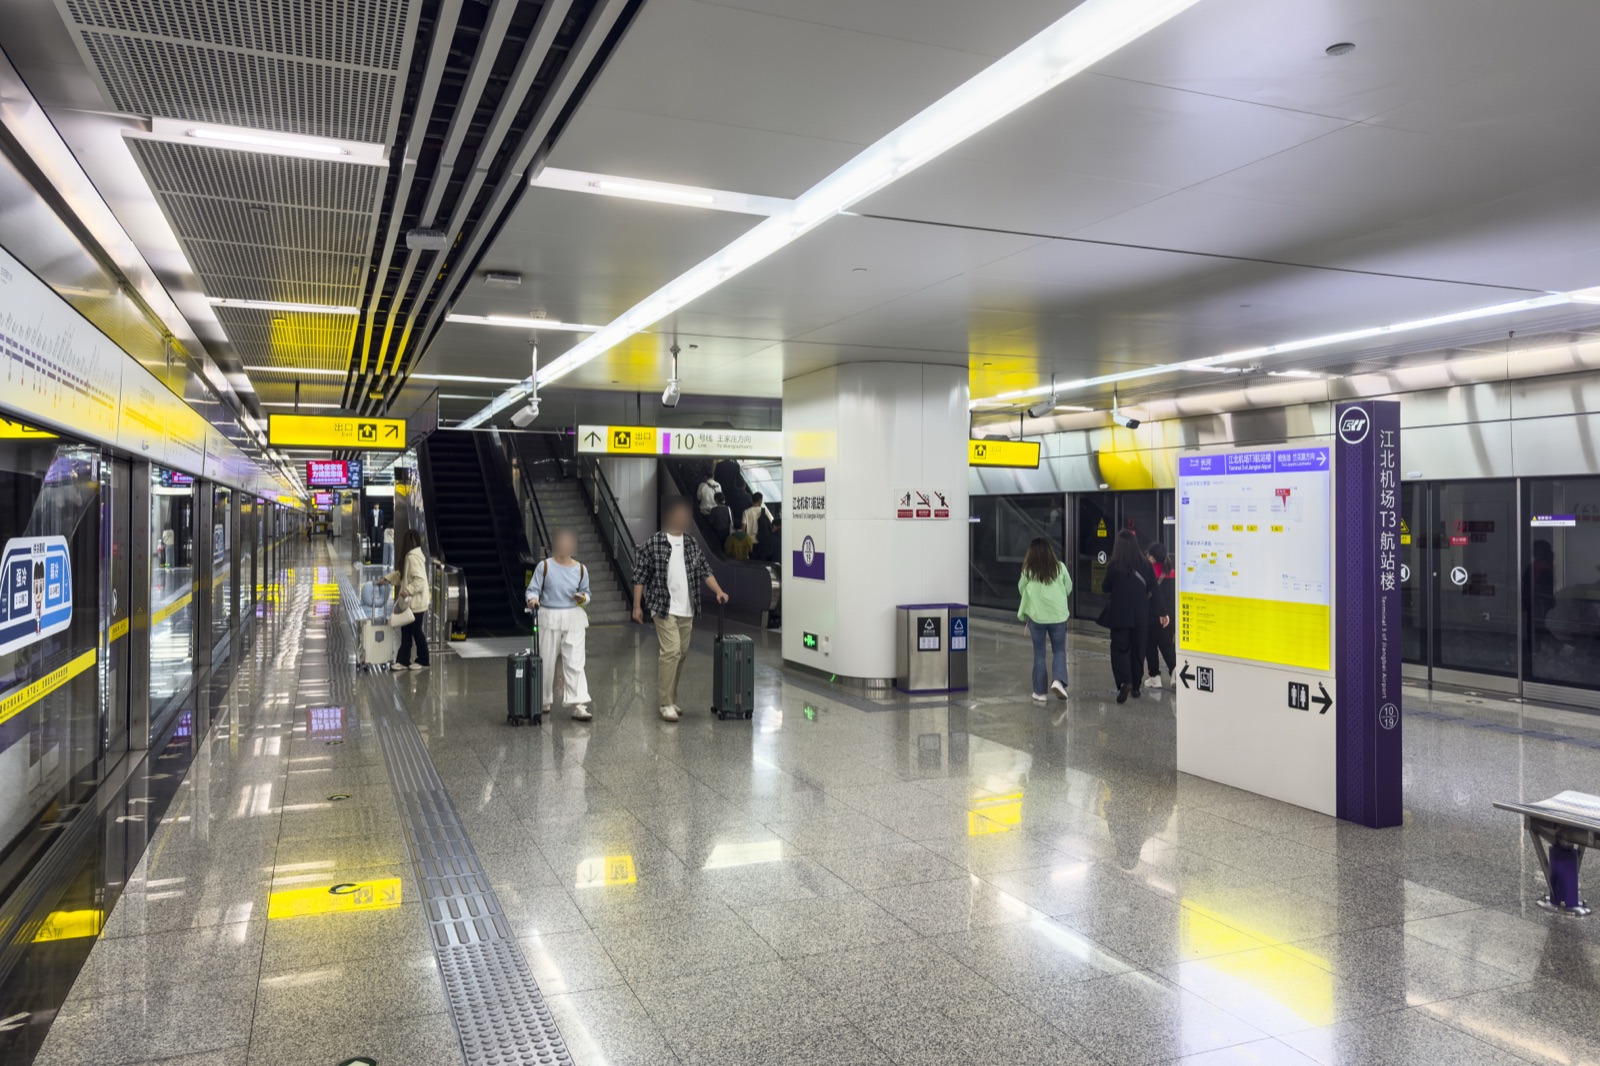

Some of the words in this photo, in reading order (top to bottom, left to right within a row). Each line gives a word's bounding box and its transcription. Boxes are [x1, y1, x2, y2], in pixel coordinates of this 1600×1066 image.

[334, 423, 353, 431] 出口
[634, 431, 651, 441] 出口
[674, 433, 695, 450] 10
[699, 433, 713, 443] 号线
[716, 434, 752, 444] 王家庄方向
[1228, 452, 1272, 465] 江北机场T3航站楼
[1380, 428, 1397, 591] 江北机场T3航站楼
[1381, 633, 1387, 641] of
[1384, 706, 1394, 716] 10
[1384, 718, 1394, 728] 19
